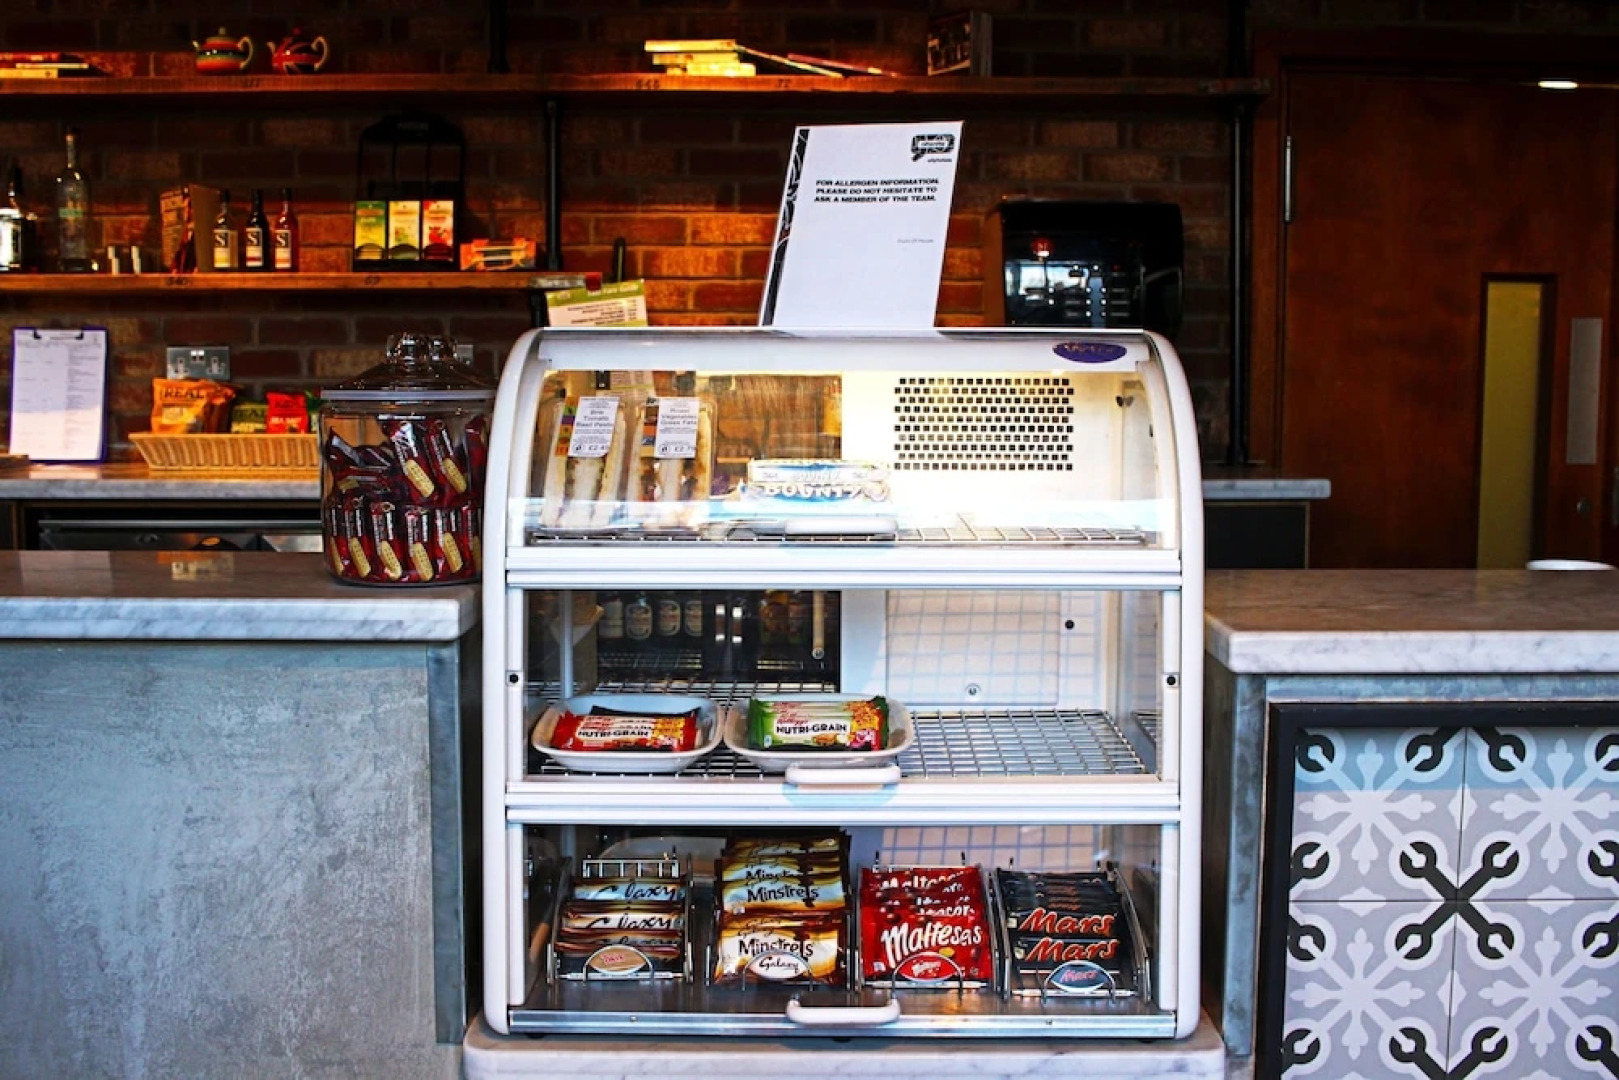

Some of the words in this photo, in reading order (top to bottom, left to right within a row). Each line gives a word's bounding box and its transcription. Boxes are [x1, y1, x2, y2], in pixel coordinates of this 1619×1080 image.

[835, 179, 878, 187] ALLERGEN
[816, 187, 848, 195] PLEASE
[849, 187, 862, 195] DO
[163, 387, 205, 399] REAL
[577, 729, 651, 739] NUTRI-GRAIN
[775, 722, 848, 735] NUTRI-GRAIN
[746, 884, 820, 903] Minstrels
[1019, 906, 1117, 936] Mars
[1024, 937, 1120, 962] Mars
[758, 956, 799, 974] Galaxy
[1060, 969, 1099, 983] Mars
